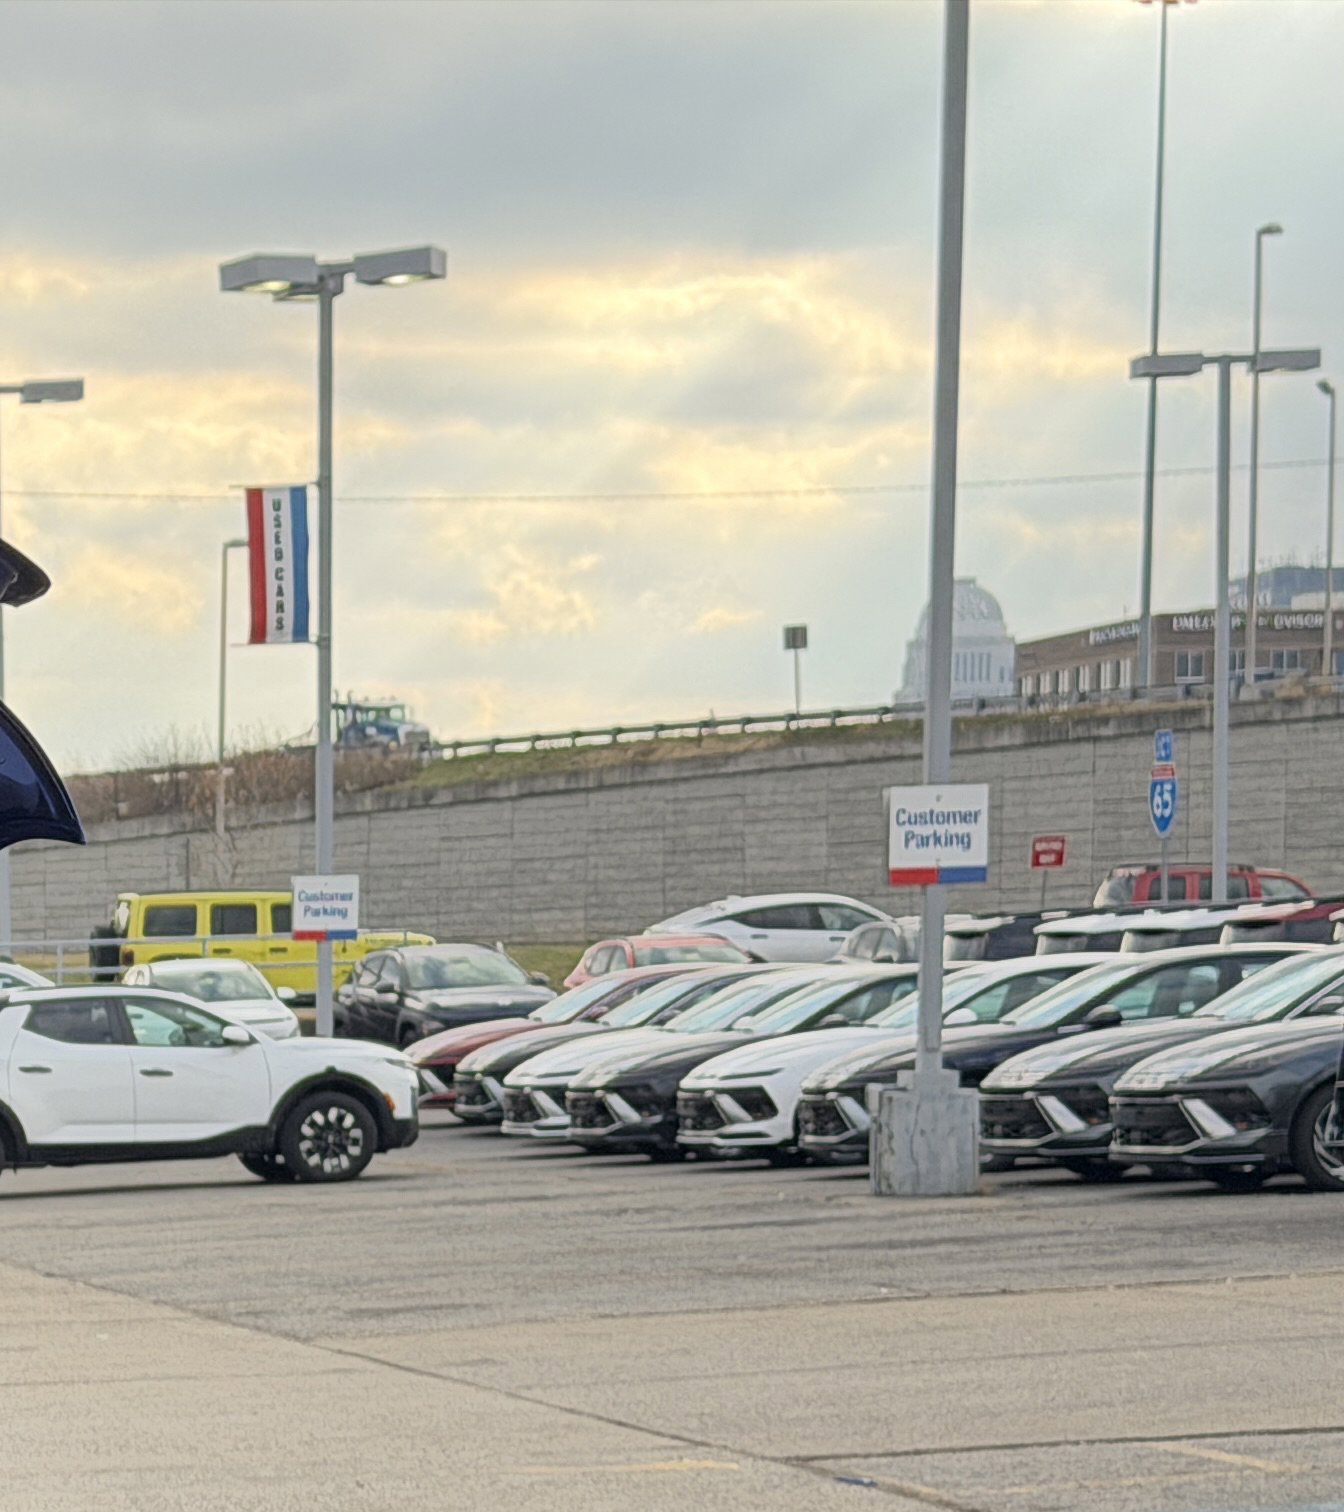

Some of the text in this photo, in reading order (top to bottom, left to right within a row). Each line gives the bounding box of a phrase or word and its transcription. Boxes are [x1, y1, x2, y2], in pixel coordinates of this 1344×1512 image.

[272, 498, 285, 631] USED CARS
[1153, 783, 1172, 818] 65
[895, 807, 982, 826] Customer
[904, 829, 972, 850] Parking
[297, 889, 354, 902] Customer
[303, 905, 349, 919] Parking
